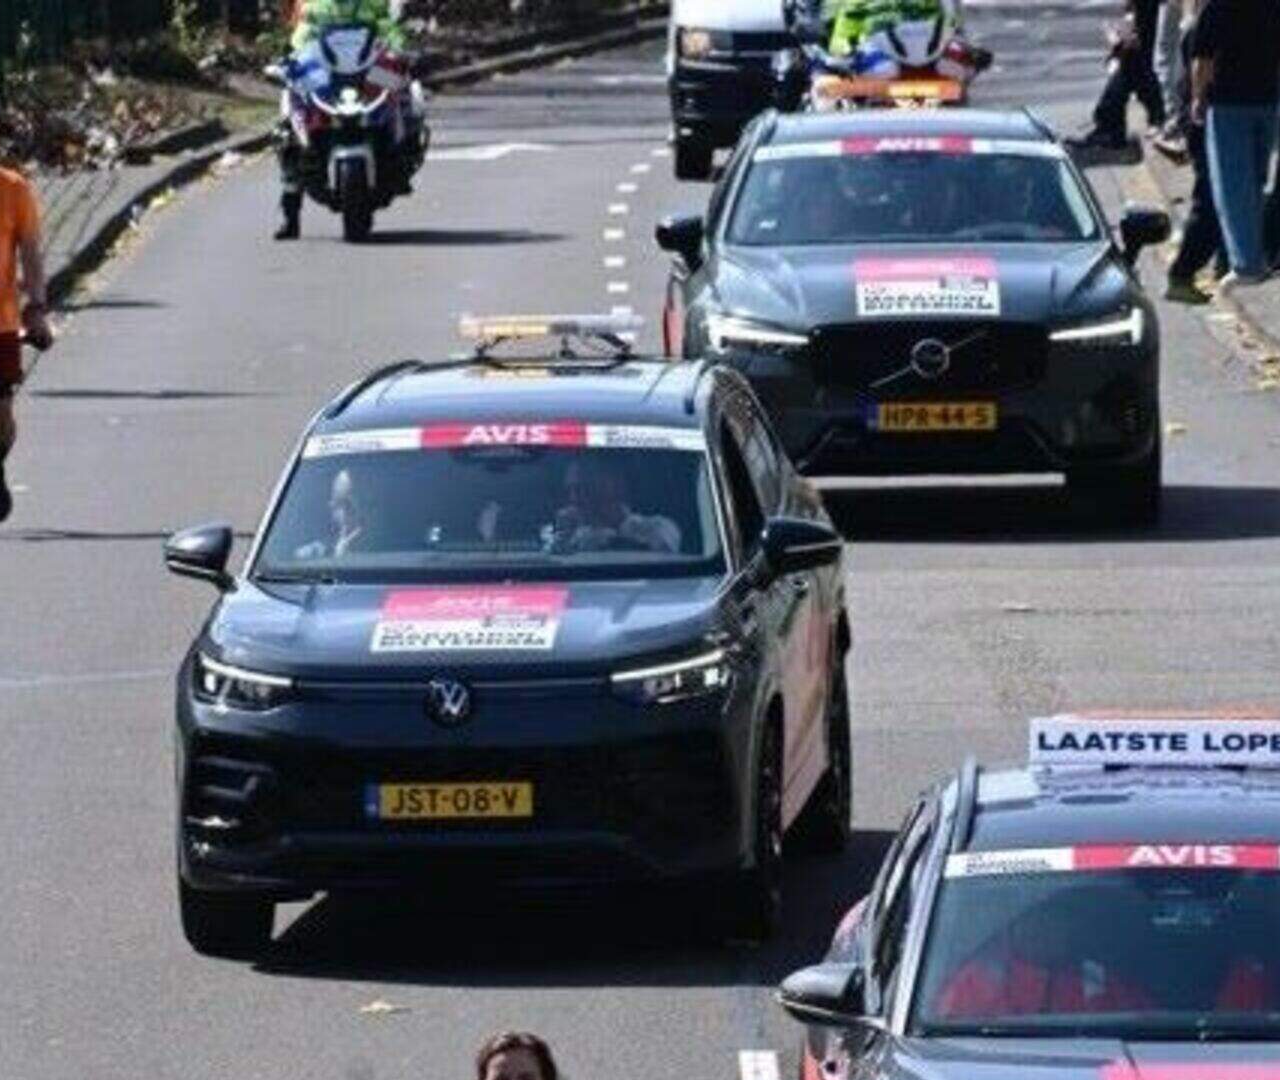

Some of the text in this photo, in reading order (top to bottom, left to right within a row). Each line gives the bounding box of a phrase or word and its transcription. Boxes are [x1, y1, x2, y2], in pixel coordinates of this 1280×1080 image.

[462, 424, 552, 444] AVIS
[1037, 732, 1187, 752] LAATSTE
[391, 787, 519, 814] JST-08-V
[1128, 845, 1236, 866] AVIS
